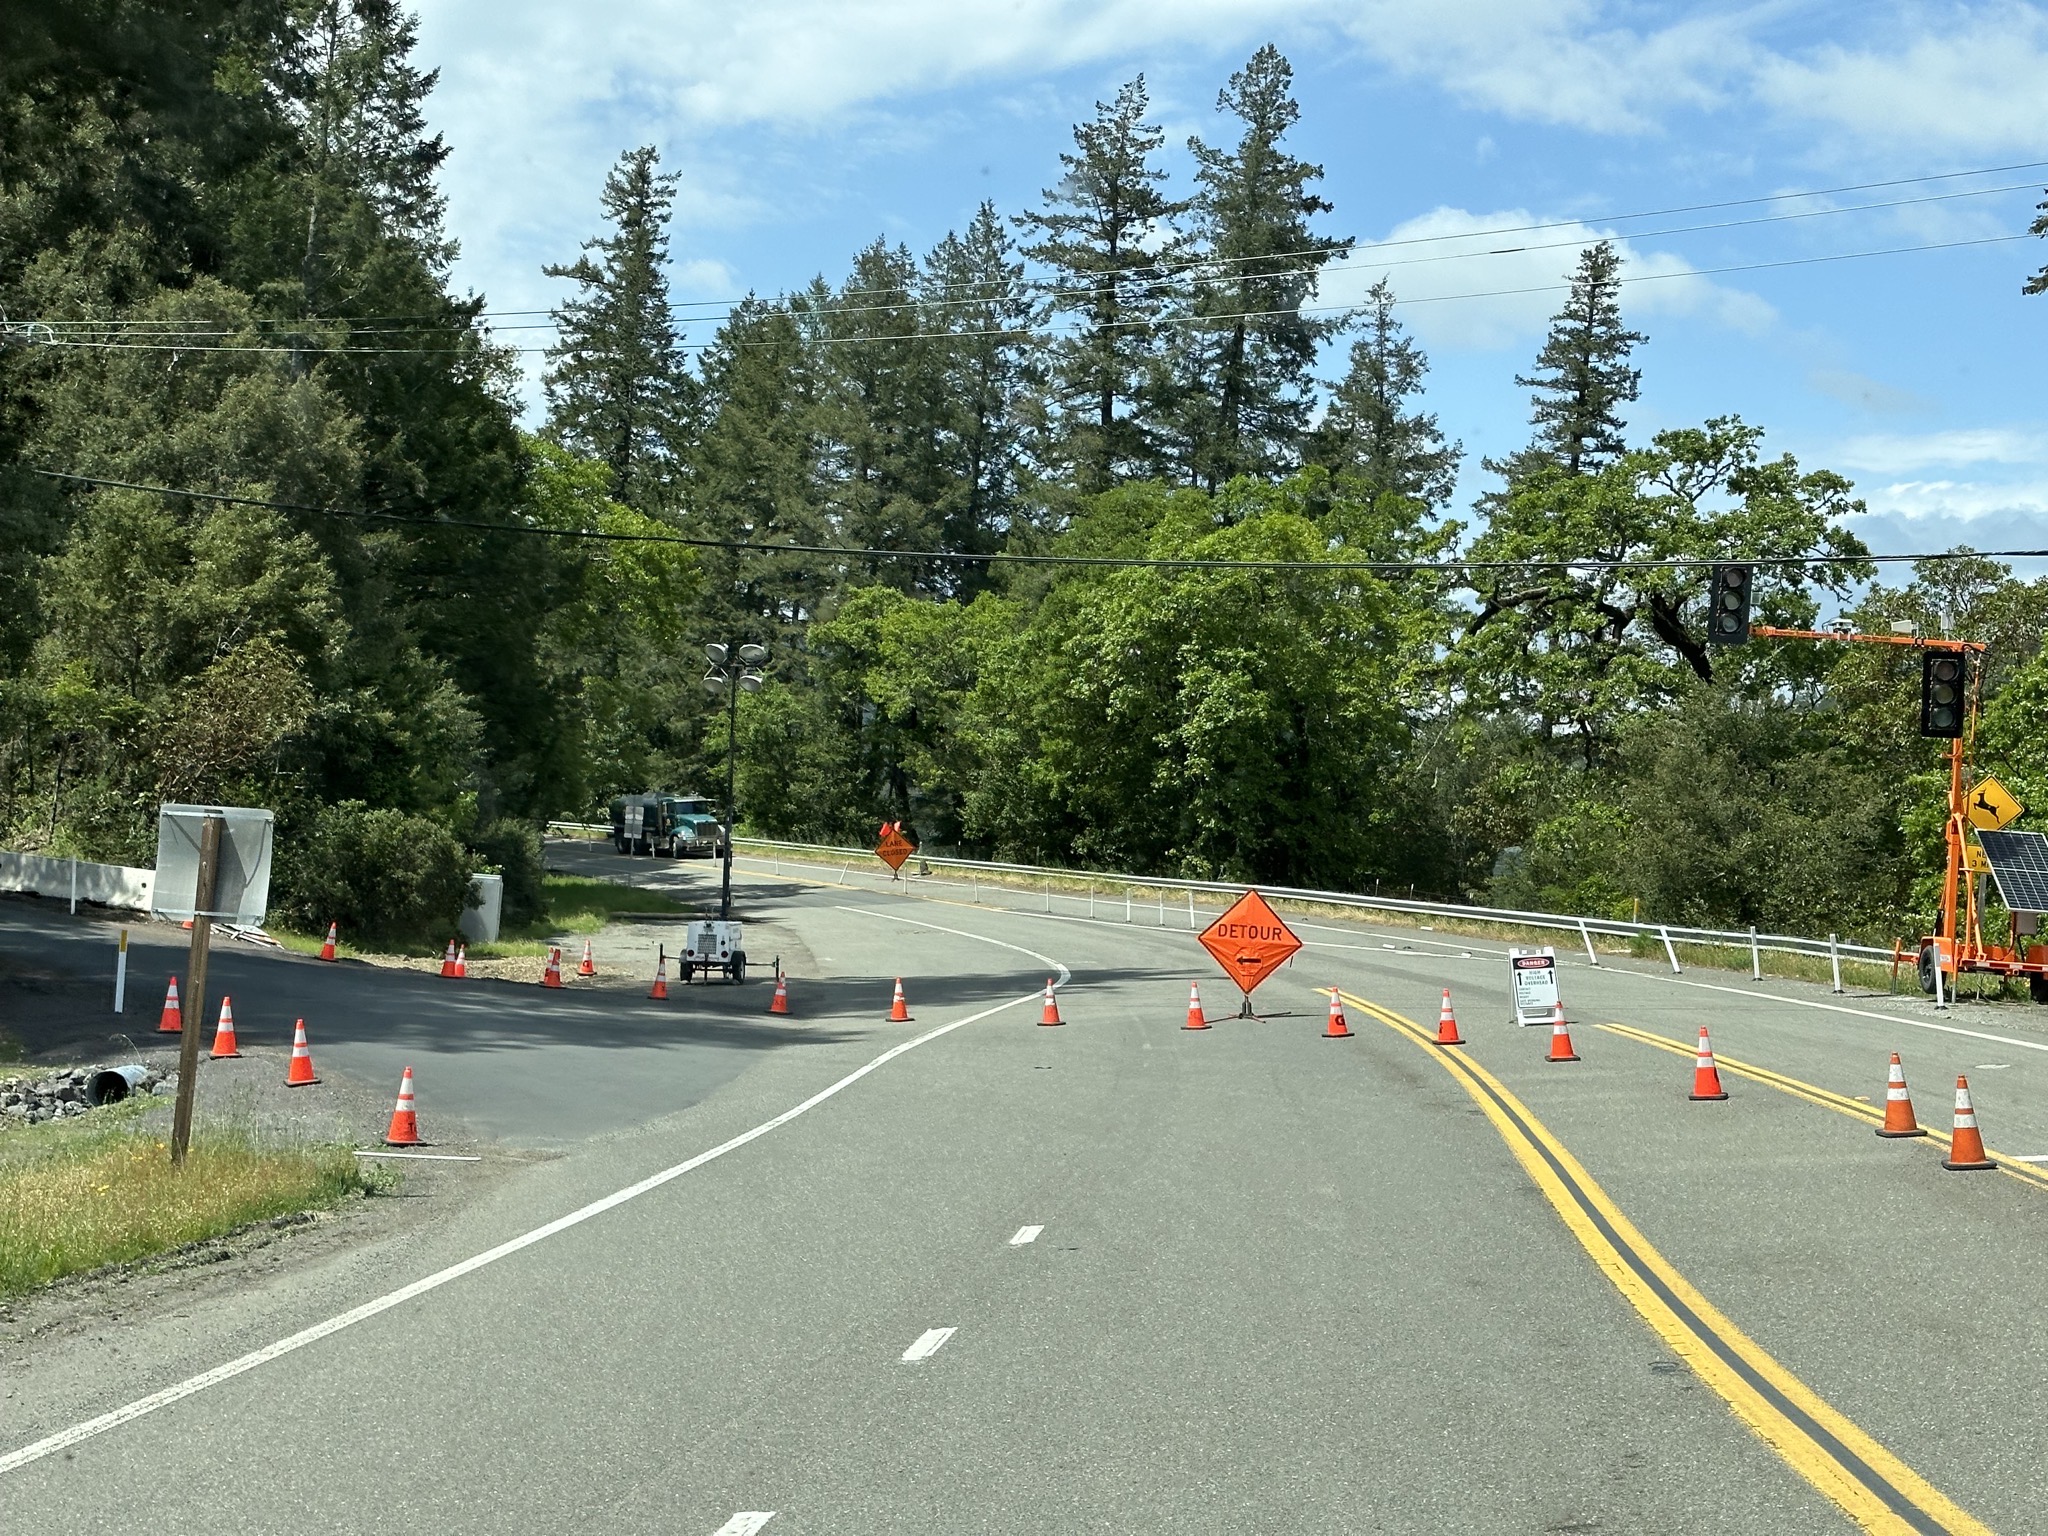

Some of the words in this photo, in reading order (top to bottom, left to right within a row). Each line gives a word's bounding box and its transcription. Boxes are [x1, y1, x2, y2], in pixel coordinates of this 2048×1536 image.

[882, 849, 907, 857] CLOSED
[1972, 860, 1978, 868] 3
[1218, 923, 1282, 941] DETOUR
